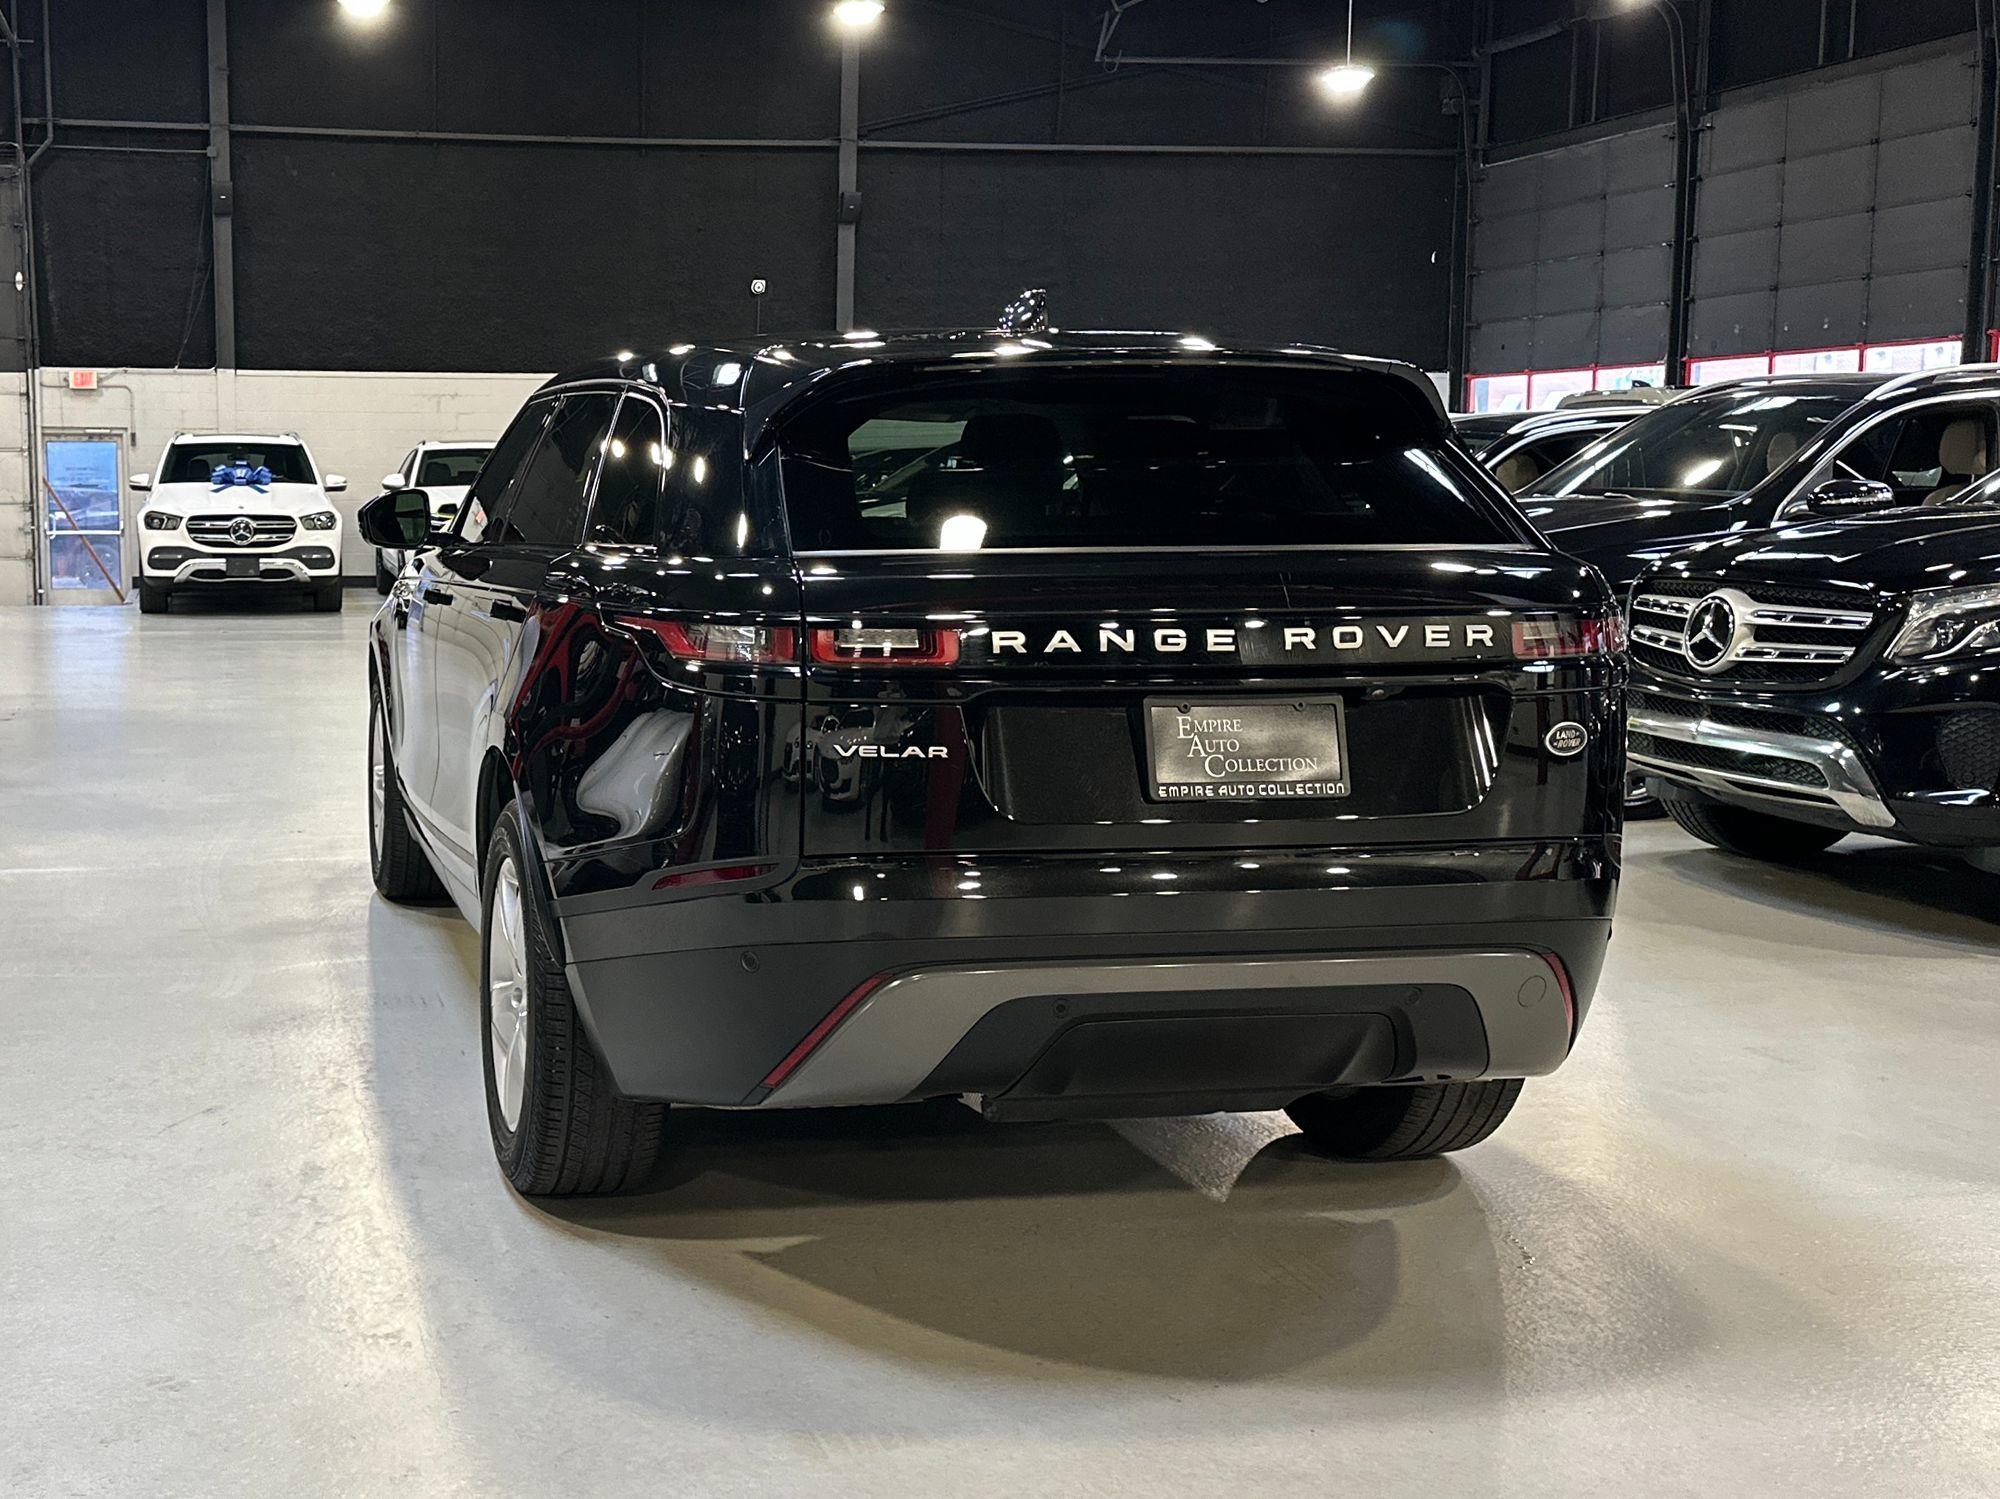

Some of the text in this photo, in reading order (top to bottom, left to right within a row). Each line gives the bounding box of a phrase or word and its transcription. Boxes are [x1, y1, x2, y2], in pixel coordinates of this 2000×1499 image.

[991, 625, 1494, 654] RANGE ROVER
[1556, 730, 1576, 740] LAND
[1557, 738, 1581, 748] ROVER
[833, 744, 949, 758] VELAR
[1158, 782, 1345, 798] EMPIRE AUTO COLLECTION
